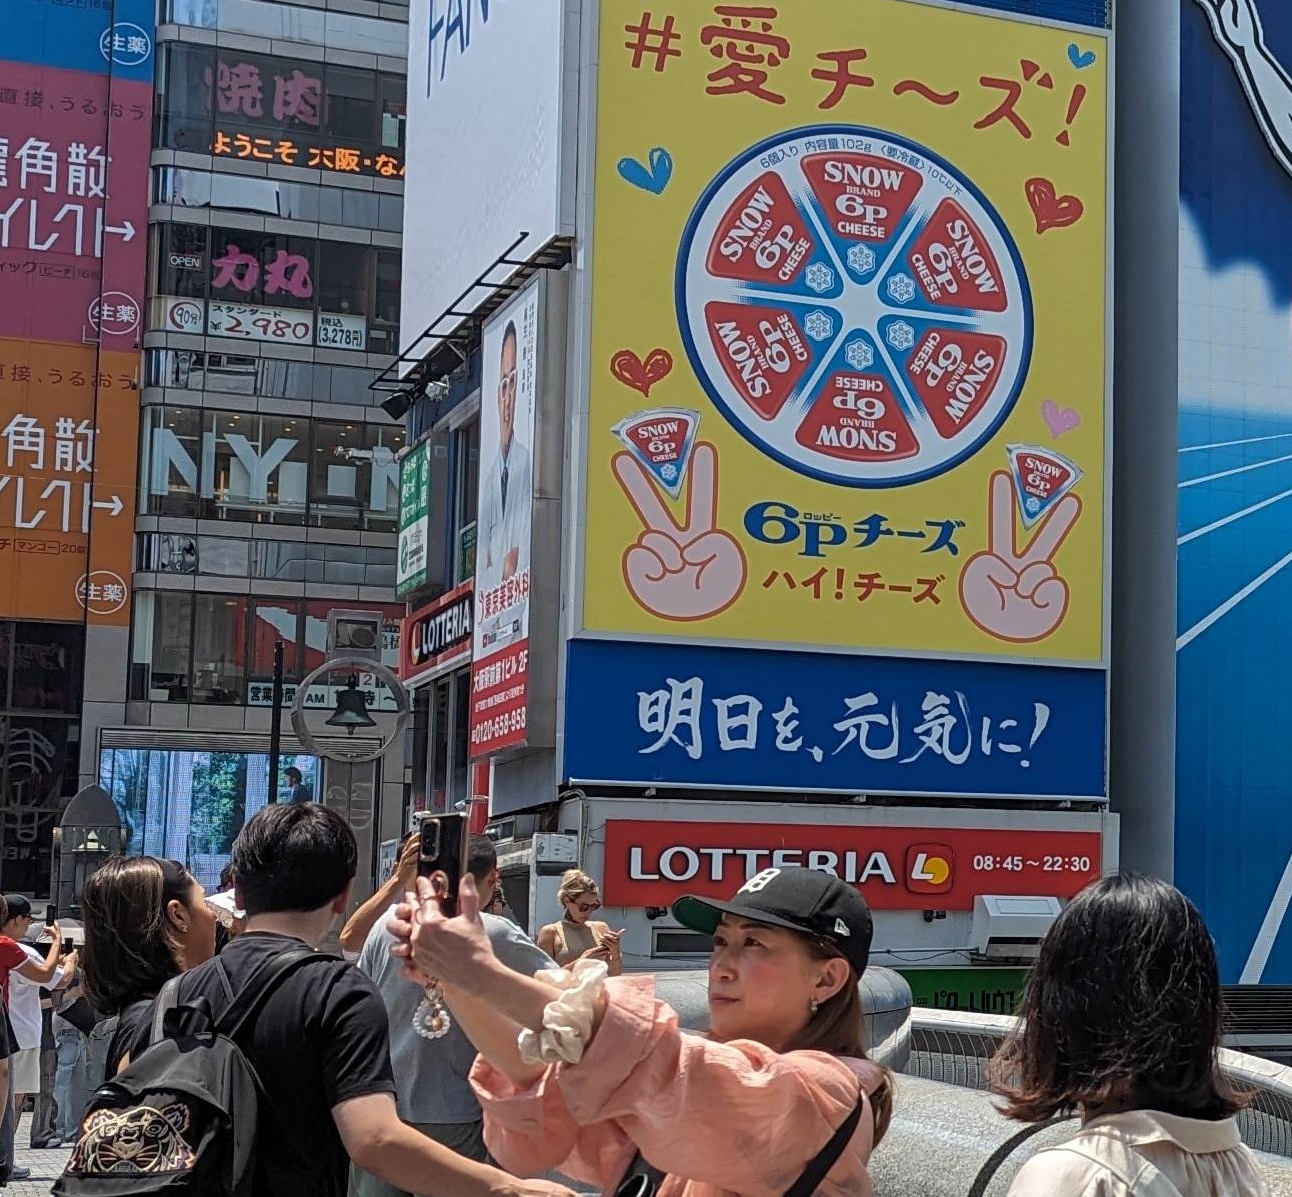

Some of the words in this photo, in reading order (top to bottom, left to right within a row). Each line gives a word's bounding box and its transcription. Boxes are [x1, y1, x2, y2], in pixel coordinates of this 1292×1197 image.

[103, 33, 147, 55] 生薬
[204, 61, 323, 128] 焼肉
[213, 130, 299, 164] ようこそ
[760, 145, 799, 169] 6個入り
[804, 137, 873, 154] 内容量102g
[0, 137, 113, 199] 角散
[823, 160, 904, 192] SNOW
[719, 185, 775, 263] SNOW
[837, 221, 886, 239] CHEESE
[170, 255, 200, 268] OPEN
[211, 243, 313, 298] 力丸
[778, 237, 811, 281] CHEESE
[946, 217, 999, 295] SNOW
[911, 253, 941, 301] CHEESE
[92, 303, 136, 323] 生薬
[176, 307, 198, 326] 90分
[212, 304, 282, 318] スタンダード
[320, 316, 344, 328] 税込
[318, 327, 363, 347] (3,278円)
[776, 313, 808, 362] CHEESE
[713, 320, 772, 399] SNOW
[909, 332, 941, 375] CHEESE
[836, 376, 884, 392] CHEESE
[945, 349, 996, 425] SNOW
[637, 421, 679, 439] SNOW
[815, 424, 898, 453] SNOW
[1024, 457, 1063, 479] SNOW
[803, 511, 842, 522] ロッピー
[17, 540, 59, 552] マンゴー
[79, 581, 123, 602] 生薬
[761, 567, 947, 605] ハイ!チーズ
[421, 599, 471, 654] LOTTERIA
[518, 649, 529, 673] 2F
[250, 686, 296, 704] 営業間
[306, 693, 325, 704] AM
[636, 676, 1052, 768] 明日を、元気に!
